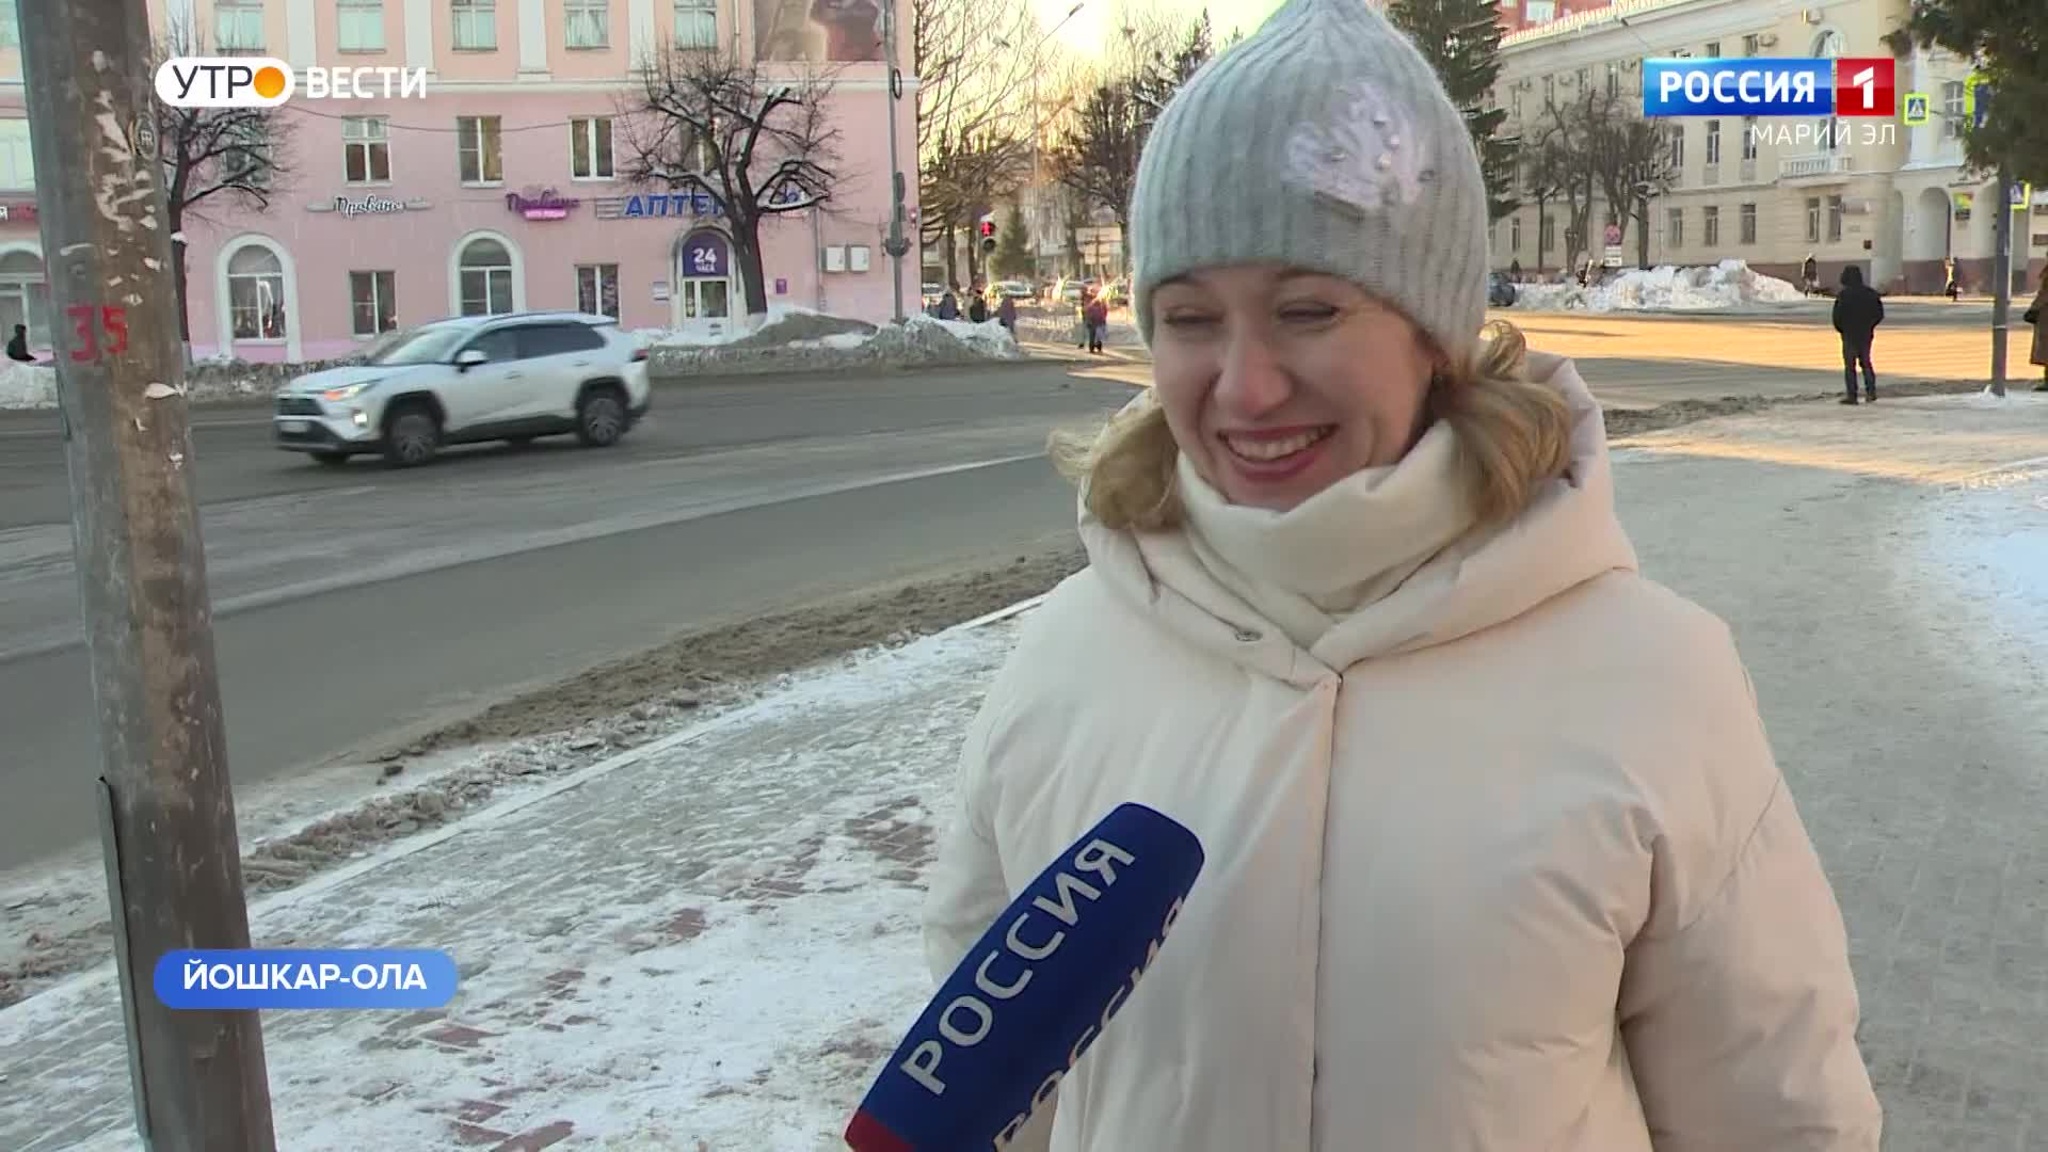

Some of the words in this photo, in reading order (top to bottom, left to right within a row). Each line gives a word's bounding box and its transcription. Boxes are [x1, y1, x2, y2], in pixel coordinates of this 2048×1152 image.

[692, 247, 718, 264] 24
[65, 305, 128, 363] 35
[900, 838, 1136, 1095] РОССИЯ
